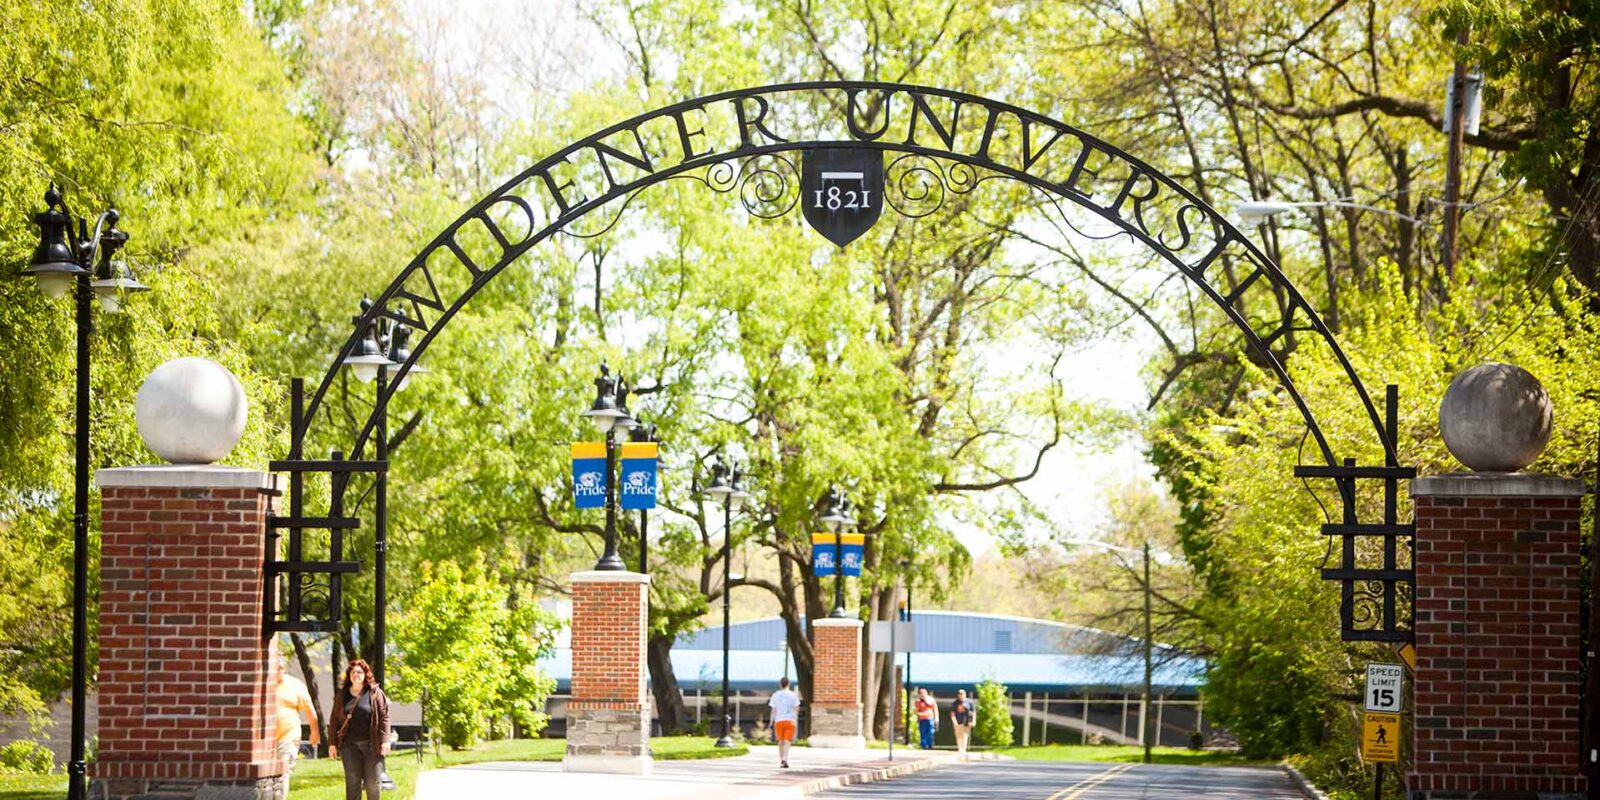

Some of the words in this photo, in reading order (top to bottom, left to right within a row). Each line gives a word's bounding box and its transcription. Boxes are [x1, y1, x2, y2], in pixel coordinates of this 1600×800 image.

[813, 186, 871, 210] 1821
[376, 93, 789, 334] WIDENER
[841, 88, 1324, 348] UNIVERSITY
[575, 482, 606, 496] Pride
[623, 481, 655, 495] Pride
[1369, 667, 1400, 677] SPEED
[1372, 679, 1396, 687] LIMIT
[1372, 689, 1395, 707] 15
[1367, 714, 1397, 723] CAUTION
